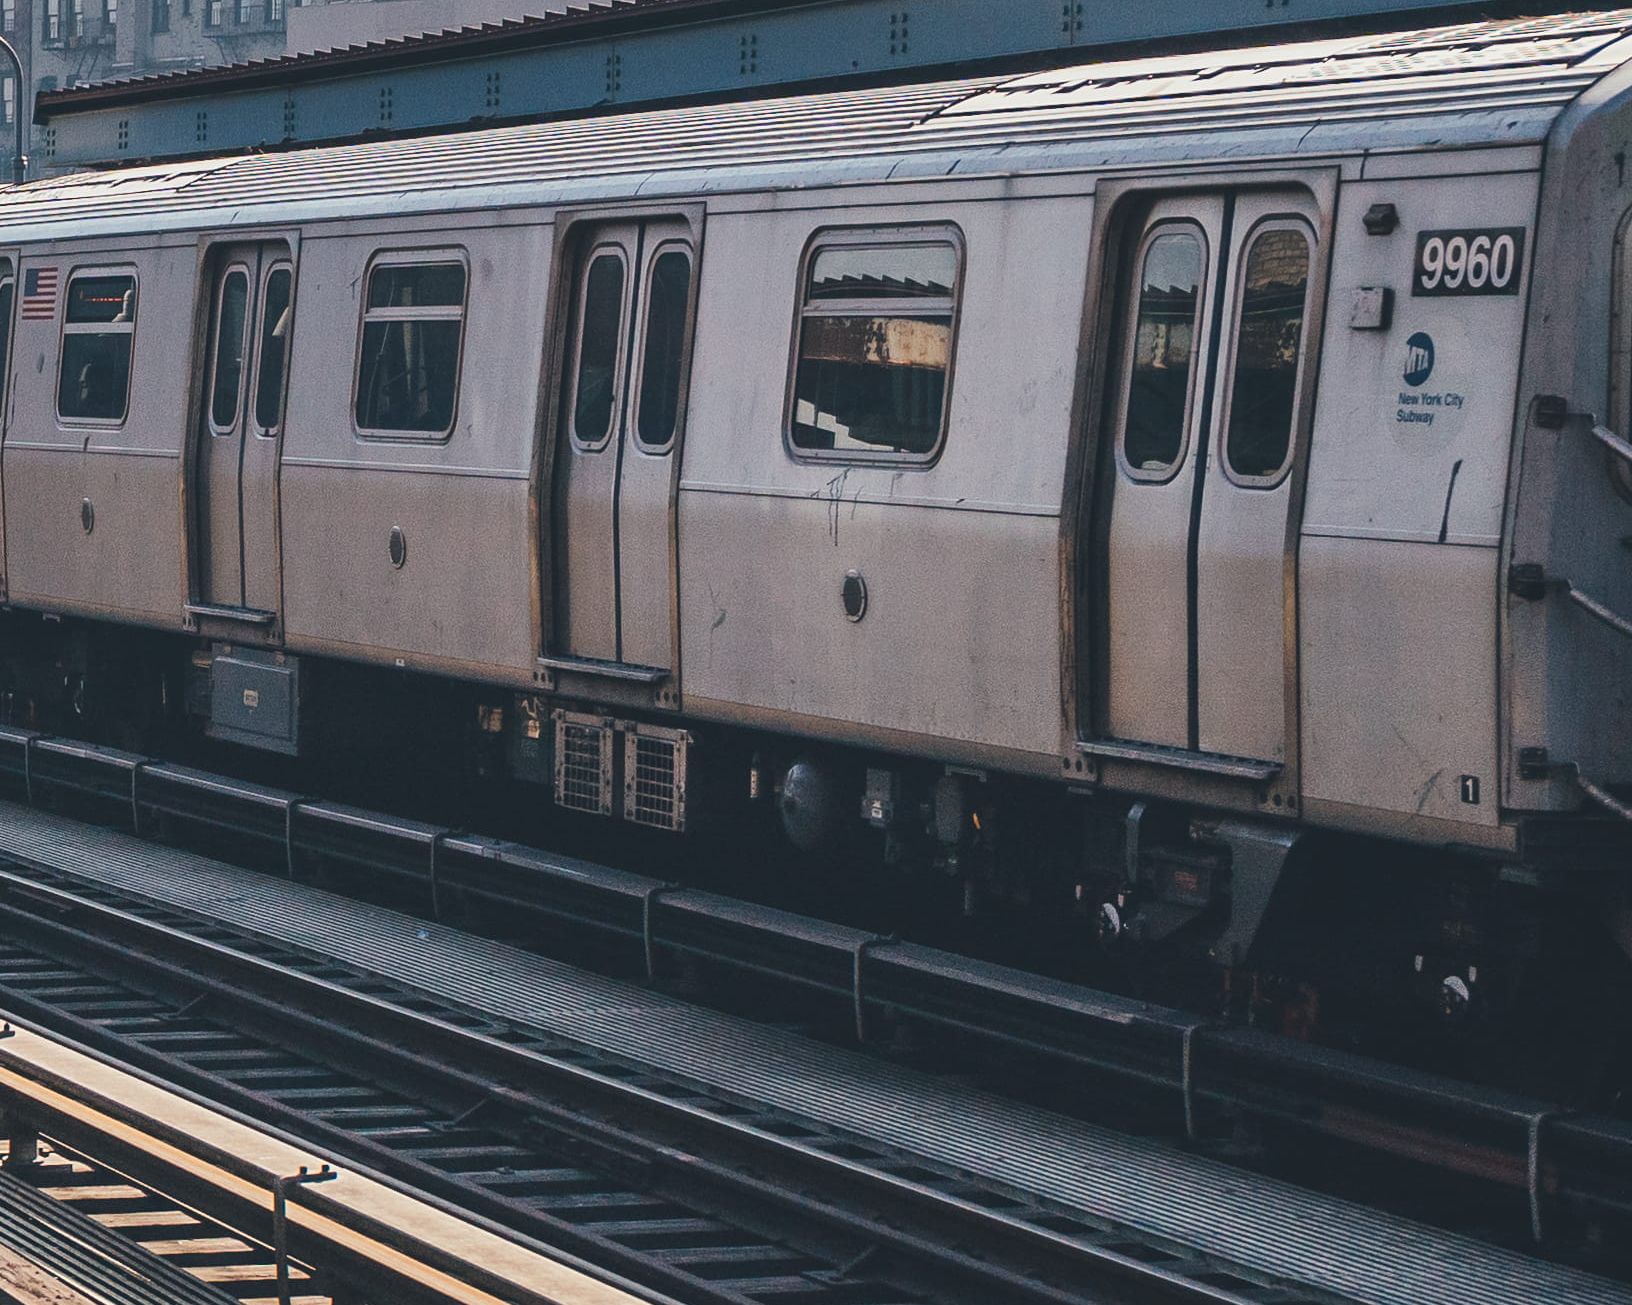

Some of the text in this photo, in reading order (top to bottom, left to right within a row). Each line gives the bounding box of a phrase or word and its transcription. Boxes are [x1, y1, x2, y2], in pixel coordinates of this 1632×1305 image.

[1421, 234, 1514, 289] 9960
[1398, 392, 1464, 409] New York City
[1396, 409, 1434, 425] Subway
[1465, 778, 1474, 802] 1
